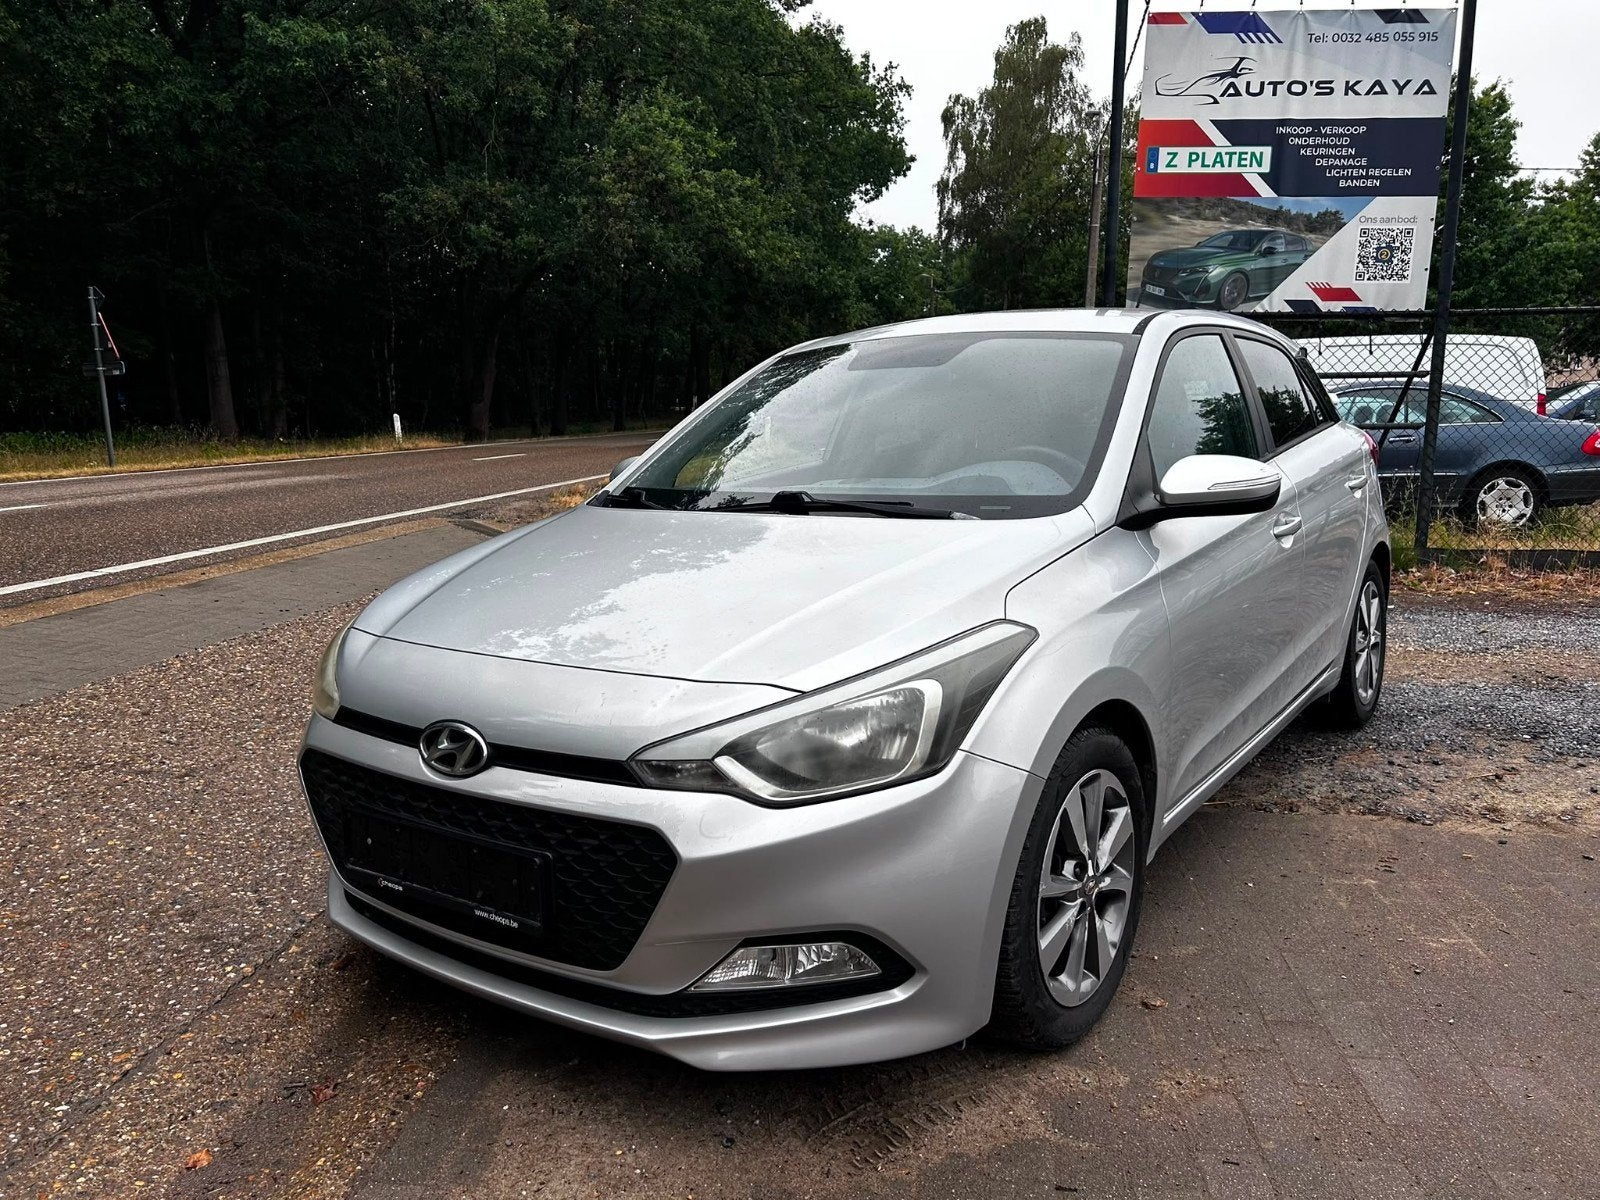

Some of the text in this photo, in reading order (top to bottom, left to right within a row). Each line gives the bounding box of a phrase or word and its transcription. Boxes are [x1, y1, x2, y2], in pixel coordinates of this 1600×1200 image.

[1308, 31, 1439, 43] Tel: 0032 485 055 915
[1219, 79, 1437, 98] AUTO'S KAYA
[1320, 126, 1367, 134] VERKOOP
[1288, 137, 1350, 145] ONDERHOUD
[1300, 147, 1355, 155] KEURINGEN
[1165, 151, 1264, 168] Z PLATEN
[1315, 158, 1368, 166] DEPANAGE
[1368, 168, 1412, 176] REGELEN
[1339, 179, 1380, 187] BANDEN
[1359, 215, 1418, 224] Ons aanbod:
[474, 909, 519, 929] www.cheops.be
